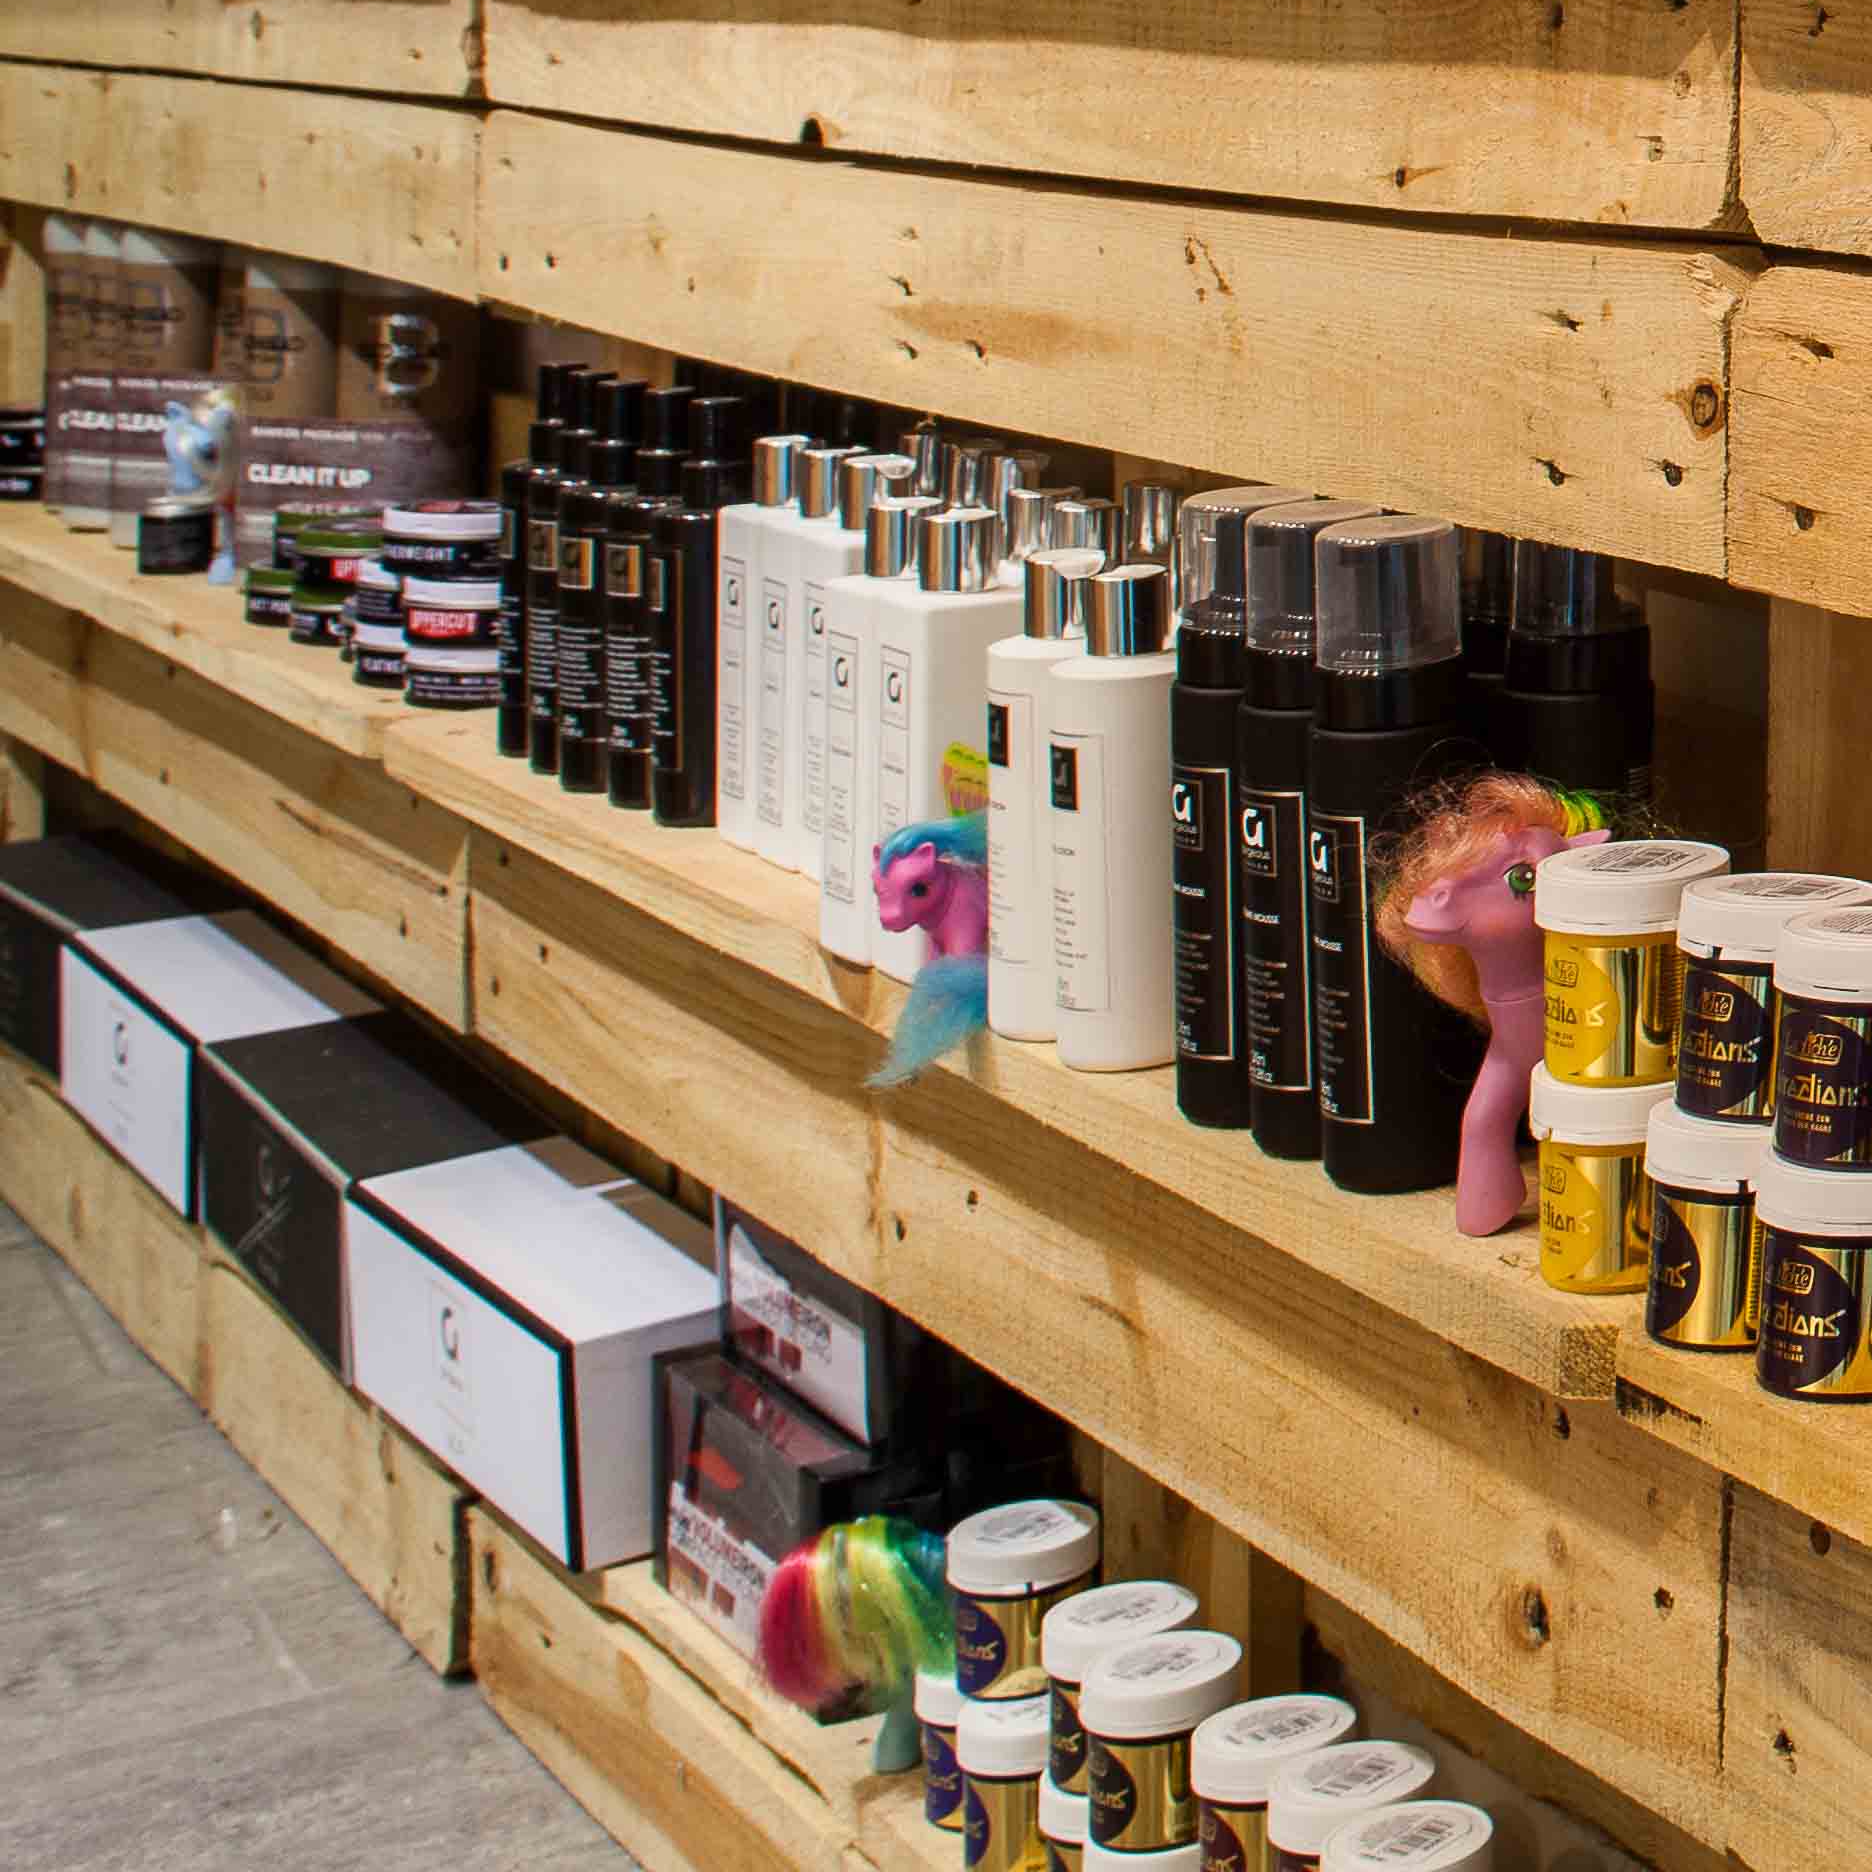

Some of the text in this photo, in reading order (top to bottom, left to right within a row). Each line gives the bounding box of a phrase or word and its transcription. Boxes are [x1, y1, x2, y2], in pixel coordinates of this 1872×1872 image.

[248, 463, 372, 488] CLEAN IT UP
